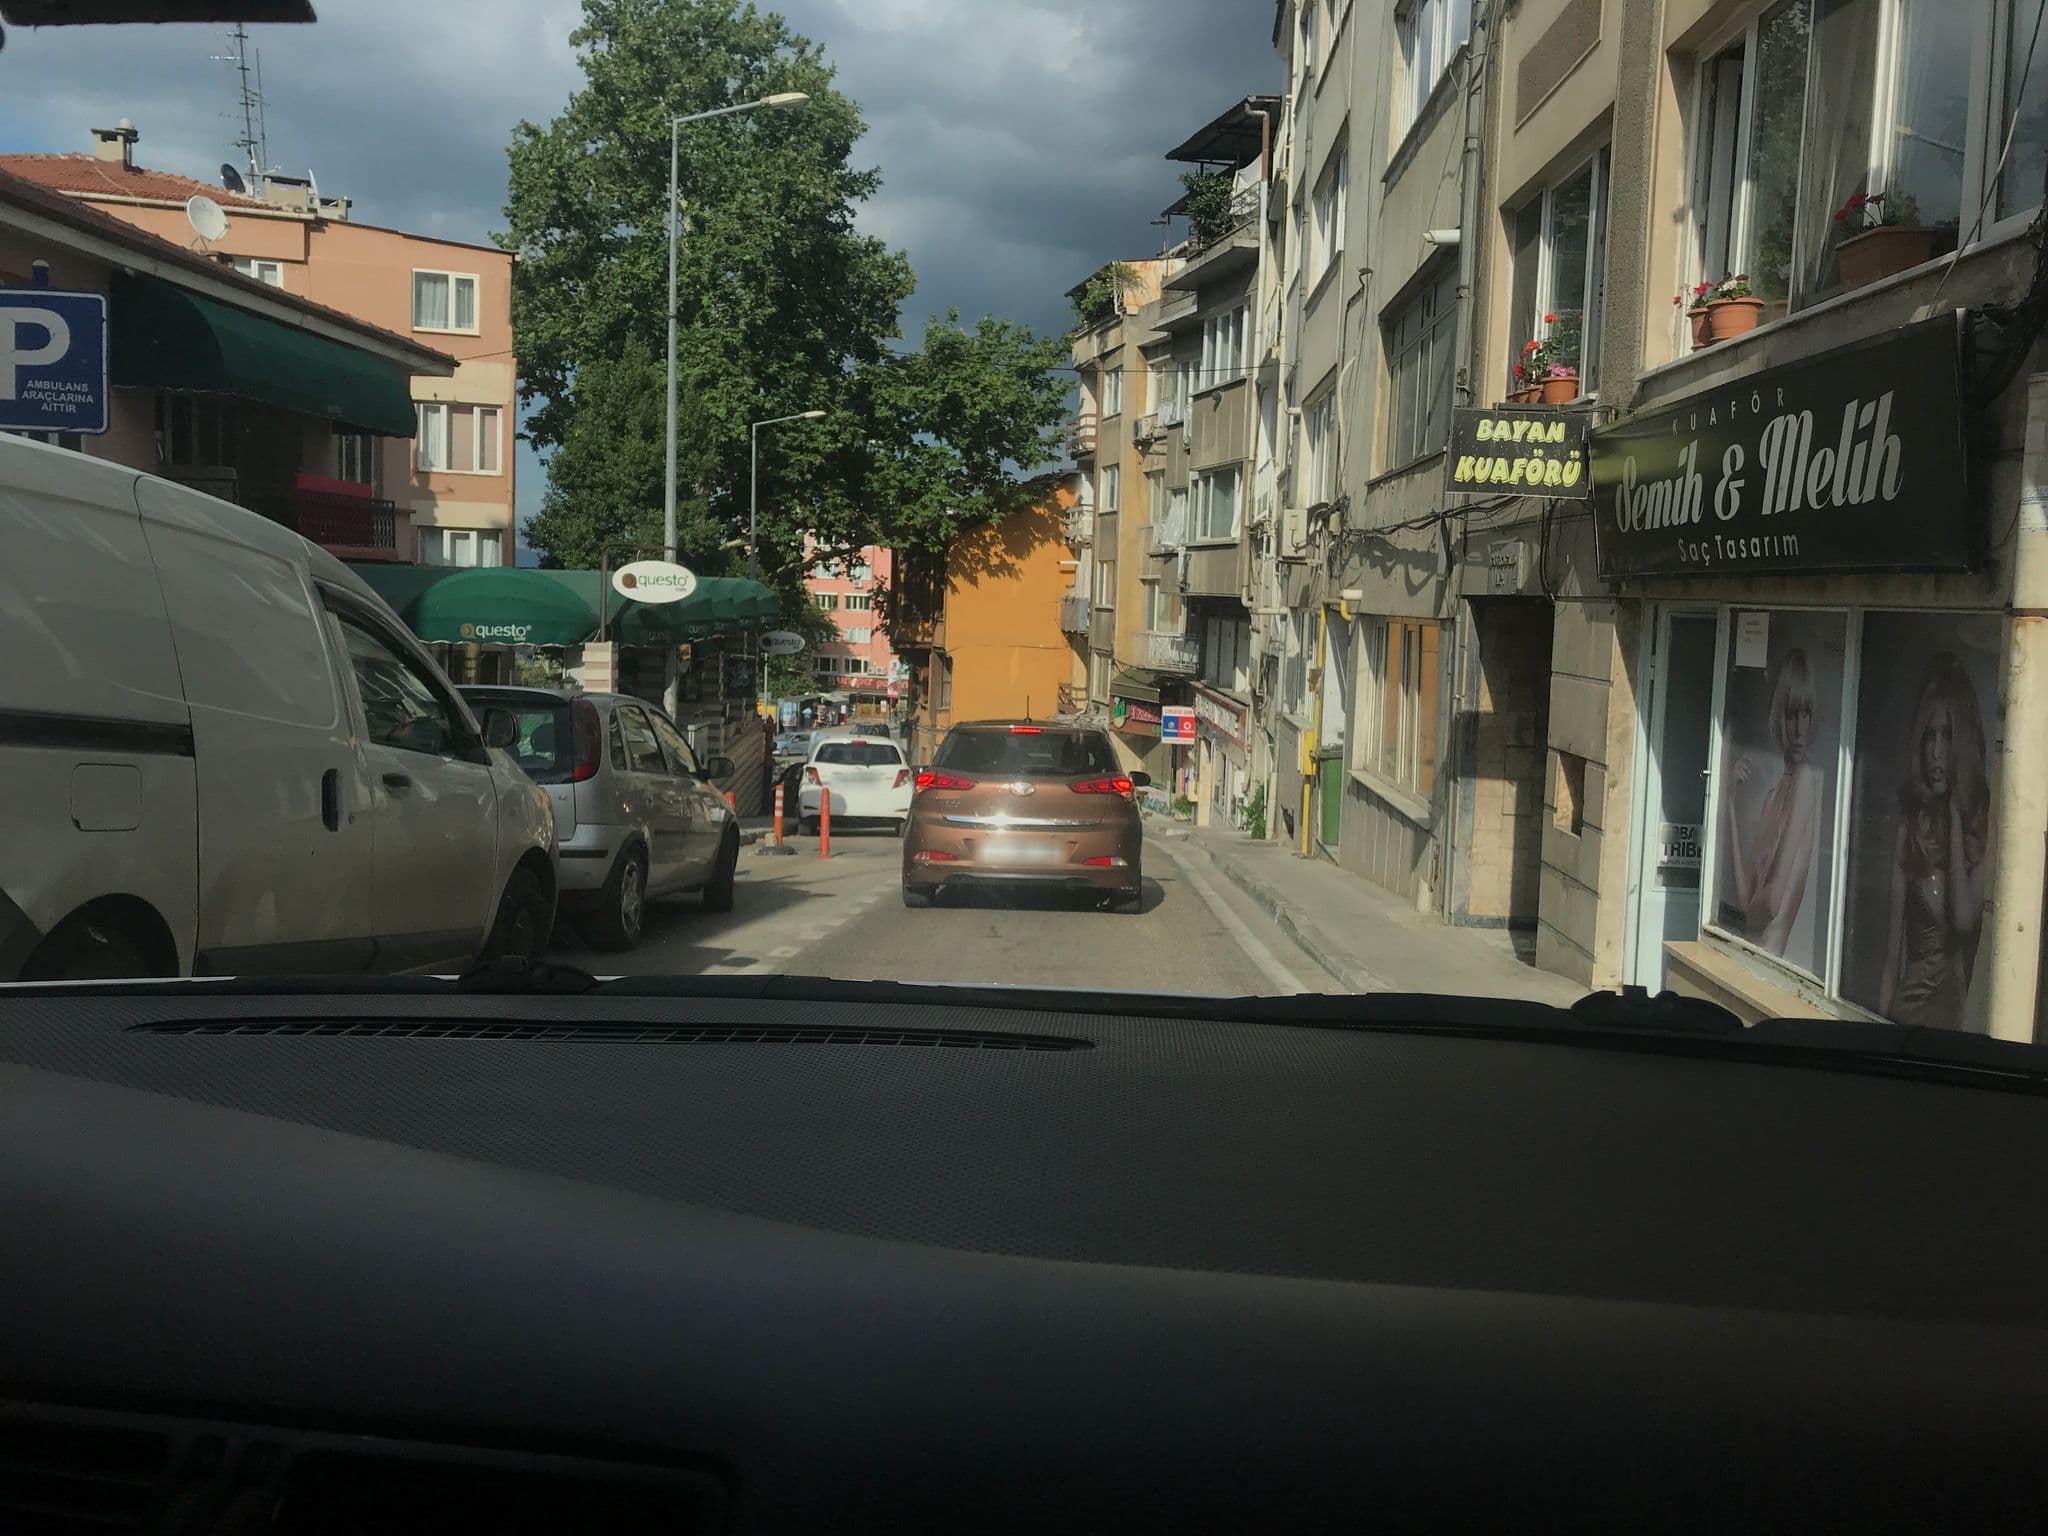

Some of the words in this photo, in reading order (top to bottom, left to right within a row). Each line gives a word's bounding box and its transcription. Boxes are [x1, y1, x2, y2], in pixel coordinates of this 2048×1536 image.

[0, 307, 70, 400] P
[26, 379, 89, 392] AMBULANS
[1672, 387, 1784, 434] KUAFÖR
[1476, 419, 1566, 443] BAYAN
[1453, 448, 1582, 487] KUAFÖRÜ
[1615, 439, 1703, 533] Semih
[1714, 443, 1745, 521] &
[1759, 389, 1903, 516] Melih
[1678, 538, 1711, 566] Saç
[1714, 533, 1799, 561] Tasarım
[638, 574, 687, 588] questo
[476, 624, 526, 638] questo
